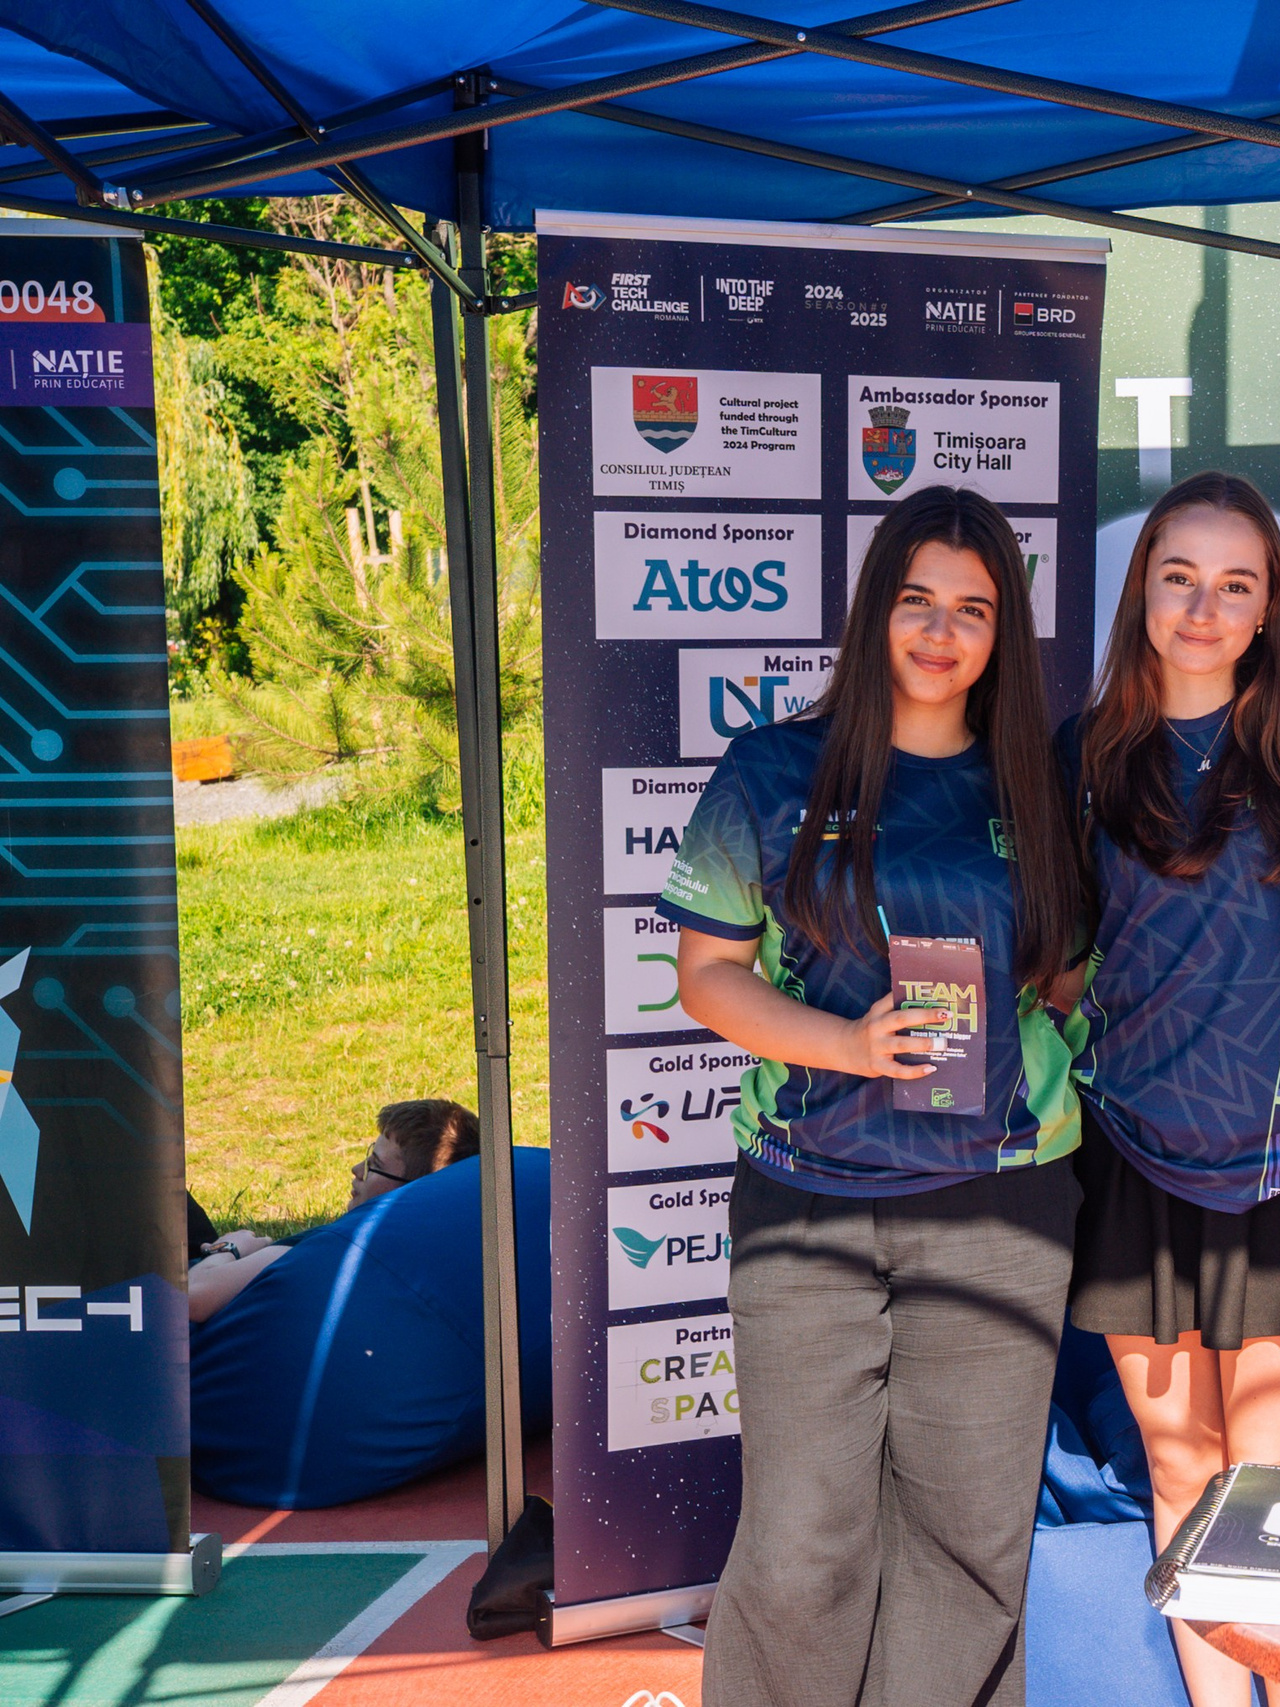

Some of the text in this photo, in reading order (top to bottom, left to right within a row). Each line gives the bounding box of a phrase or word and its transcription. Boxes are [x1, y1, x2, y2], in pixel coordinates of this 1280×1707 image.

[611, 273, 651, 286] FIRST
[611, 287, 648, 299] TECH
[716, 278, 774, 299] INTO THE
[805, 285, 843, 300] 2024
[925, 287, 987, 296] ORGANIZATOR
[611, 300, 690, 314] CHALLENGE
[729, 296, 764, 312] DEEP
[654, 314, 690, 322] ROMANIA
[850, 312, 887, 327] 2025
[925, 301, 986, 325] NAȚIE
[1037, 308, 1076, 323] BRD
[925, 324, 986, 335] PRIN EDUCAȚIE
[32, 350, 124, 378] NAȚIE
[34, 379, 125, 390] PRIN EDUCAȚIE
[719, 397, 799, 410] Cultural project
[859, 385, 1049, 409] Ambassador Sponsor
[719, 411, 799, 424] funded through
[721, 426, 797, 437] the TimCultura
[723, 440, 795, 452] 2024 Program
[933, 431, 1026, 454] Timișoara
[933, 453, 1012, 473] City Hall
[600, 464, 731, 478] CONSILIUL JUDEȚEAN
[649, 480, 685, 493] TIMIȘ
[624, 522, 794, 543] Diamond Sponsor
[632, 559, 788, 612] Atos
[764, 655, 813, 672] Main
[626, 826, 688, 854] HA
[899, 980, 977, 1002] TEAM
[649, 1054, 693, 1073] Gold
[649, 1190, 693, 1209] Gold
[676, 1326, 733, 1345] Partn
